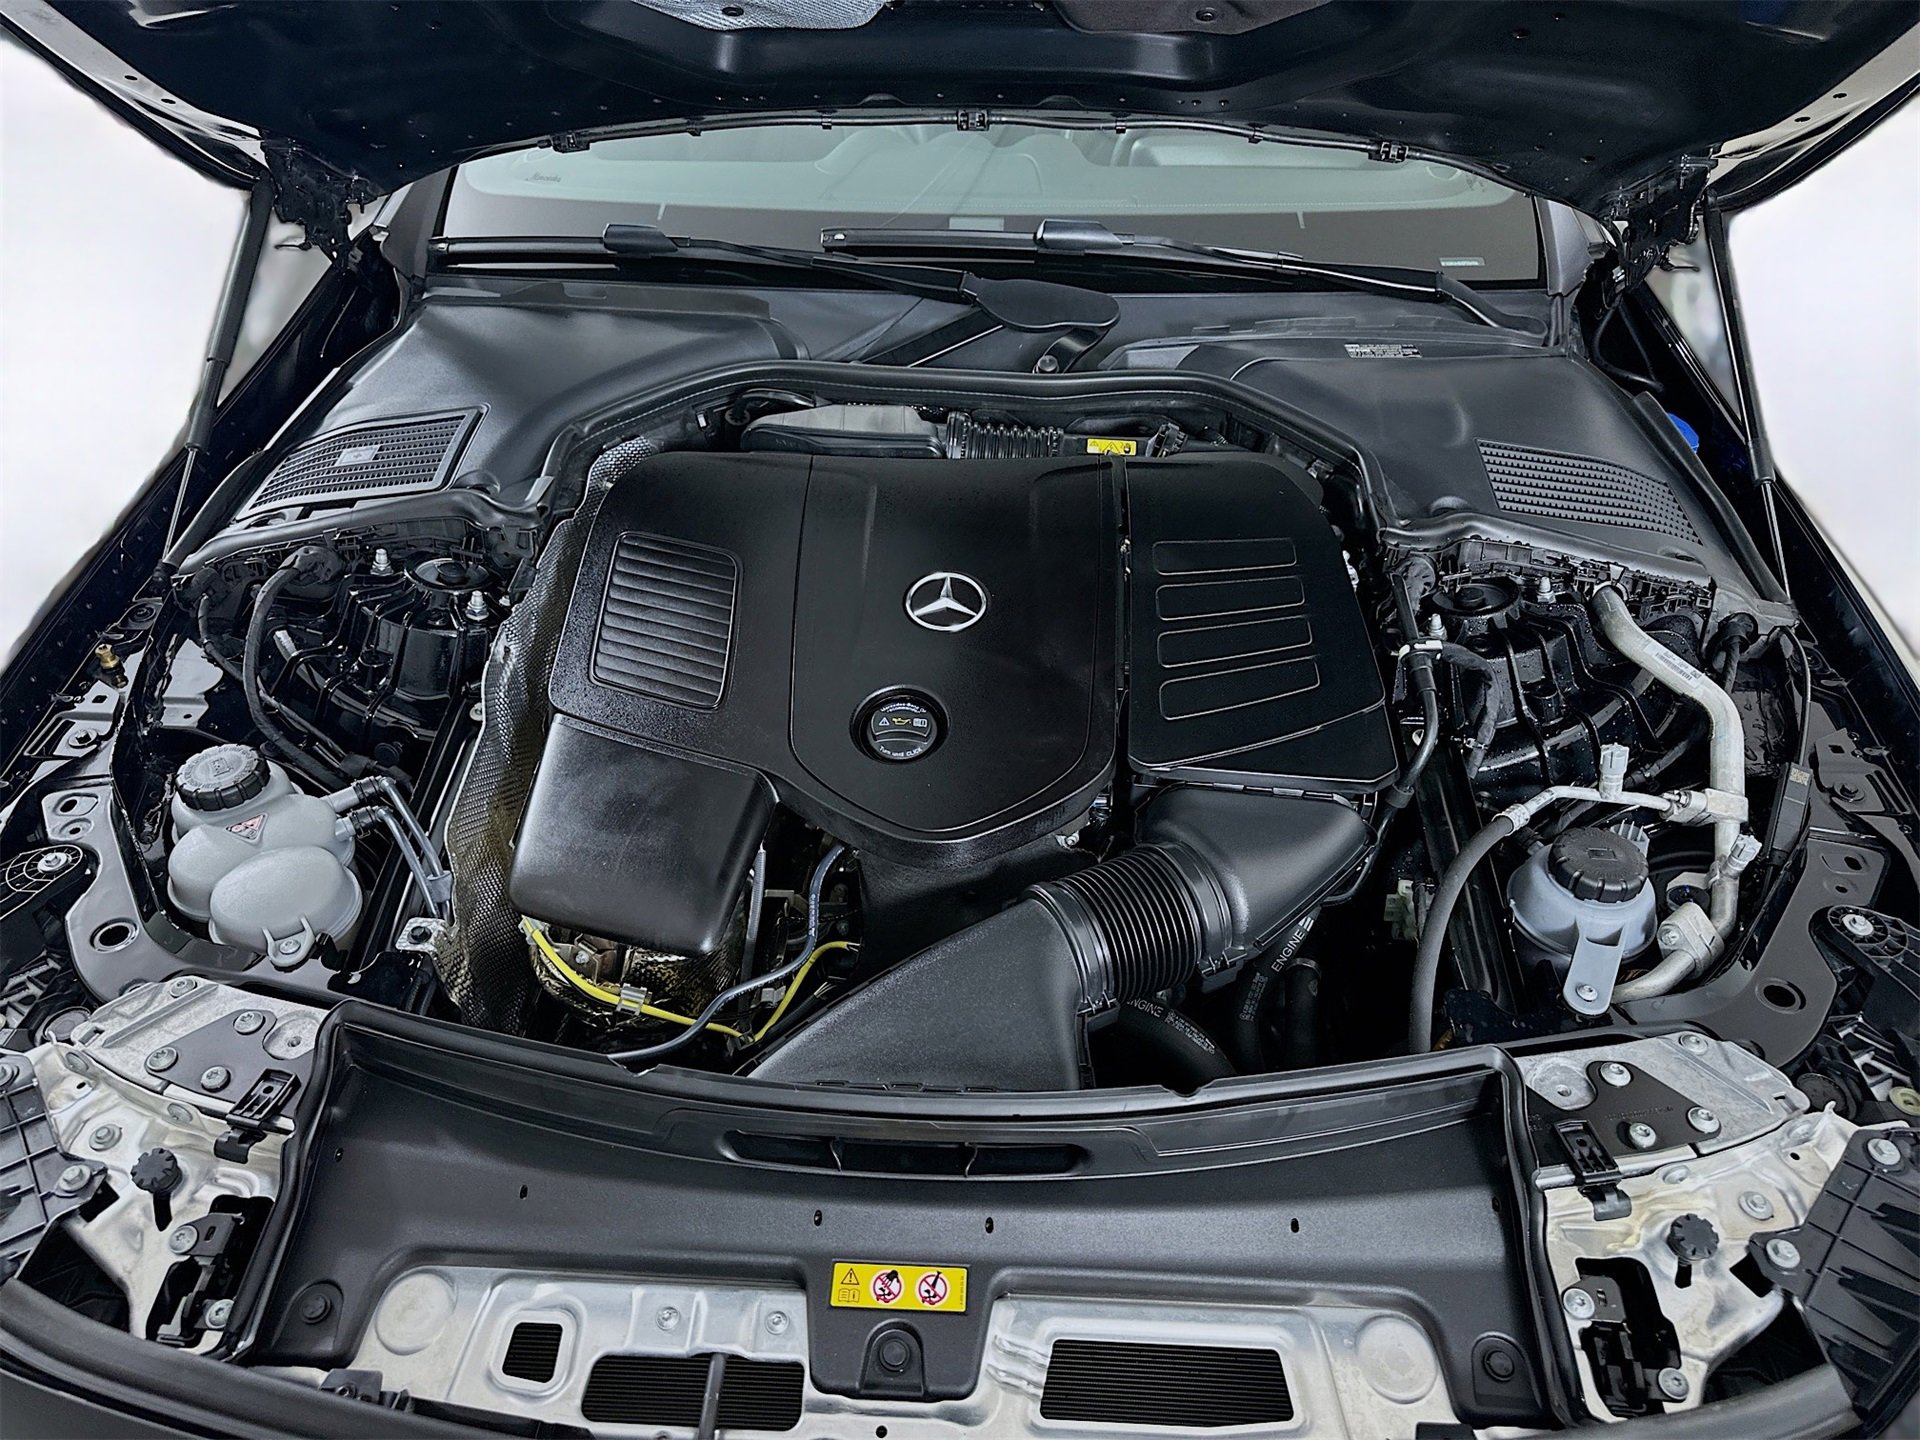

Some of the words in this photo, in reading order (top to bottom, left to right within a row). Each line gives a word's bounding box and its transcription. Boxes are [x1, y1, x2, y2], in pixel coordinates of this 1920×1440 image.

[879, 745, 890, 754] Turn
[1271, 928, 1305, 973] ENGINE
[1127, 998, 1164, 1018] NGINE
